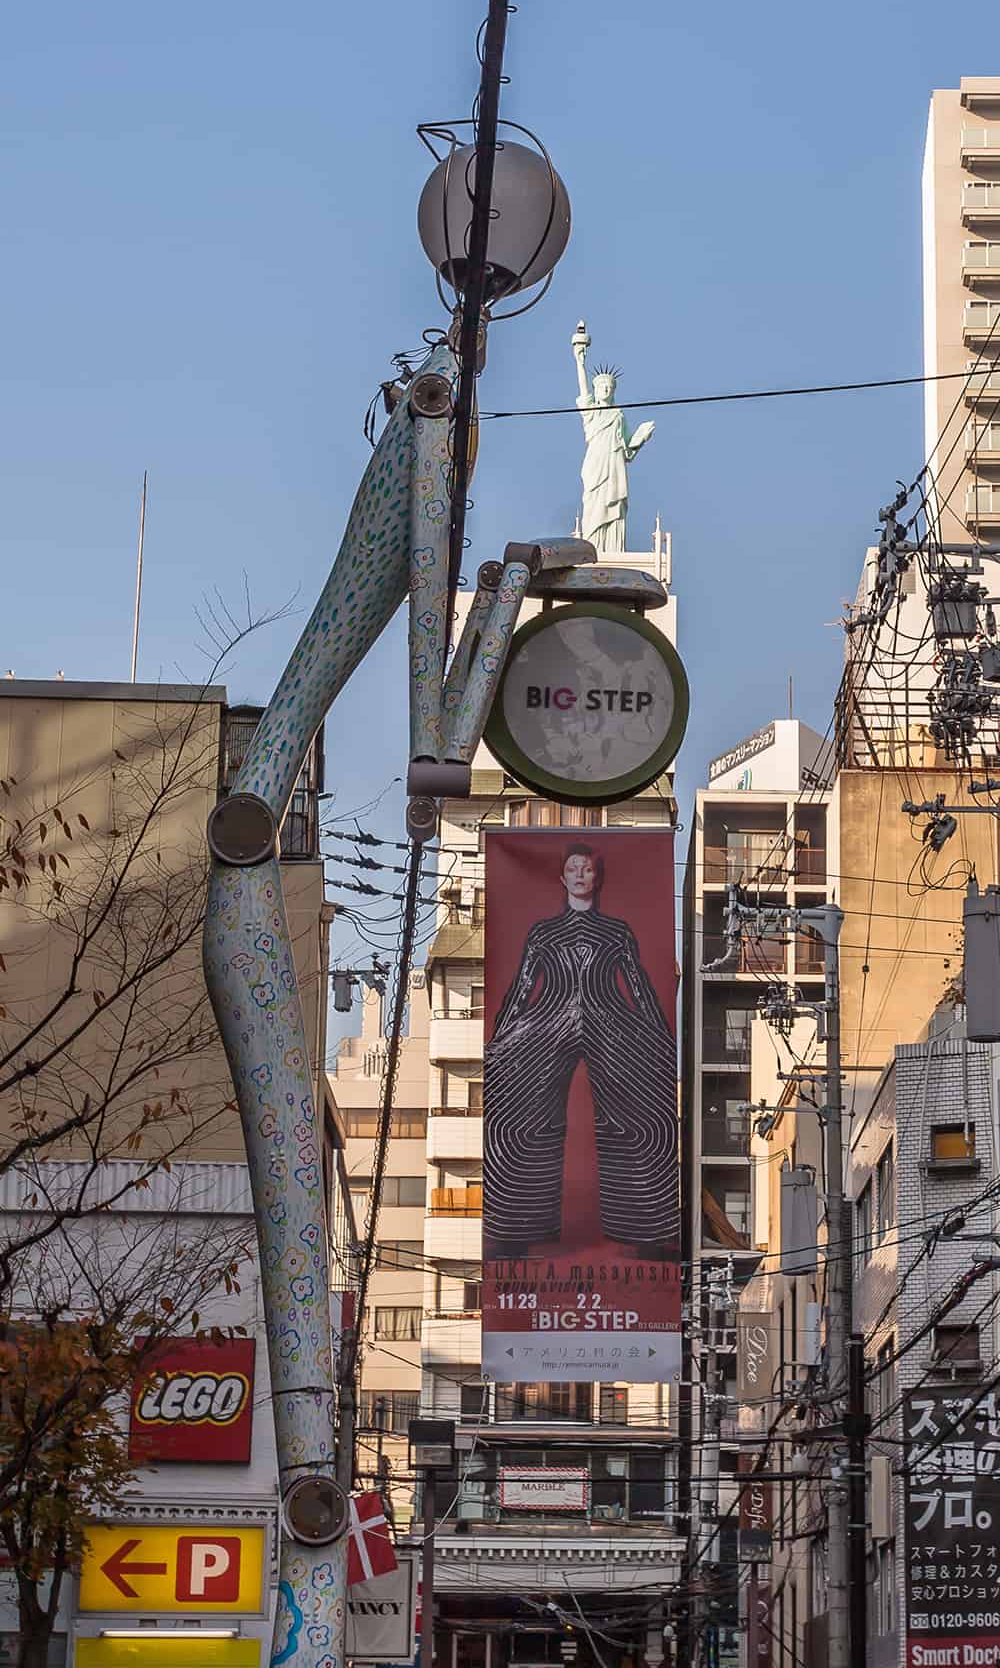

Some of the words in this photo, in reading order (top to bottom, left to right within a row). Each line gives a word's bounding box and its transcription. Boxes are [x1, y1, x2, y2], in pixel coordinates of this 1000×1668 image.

[526, 686, 577, 710] BIG
[586, 689, 653, 712] STEP
[584, 1312, 639, 1329] STEP
[140, 1376, 243, 1420] LEGO
[911, 1543, 998, 1559] スマートフォ
[190, 1544, 230, 1596] P
[911, 1584, 1000, 1601] 安心プロショッ
[912, 1644, 960, 1666] Smart
